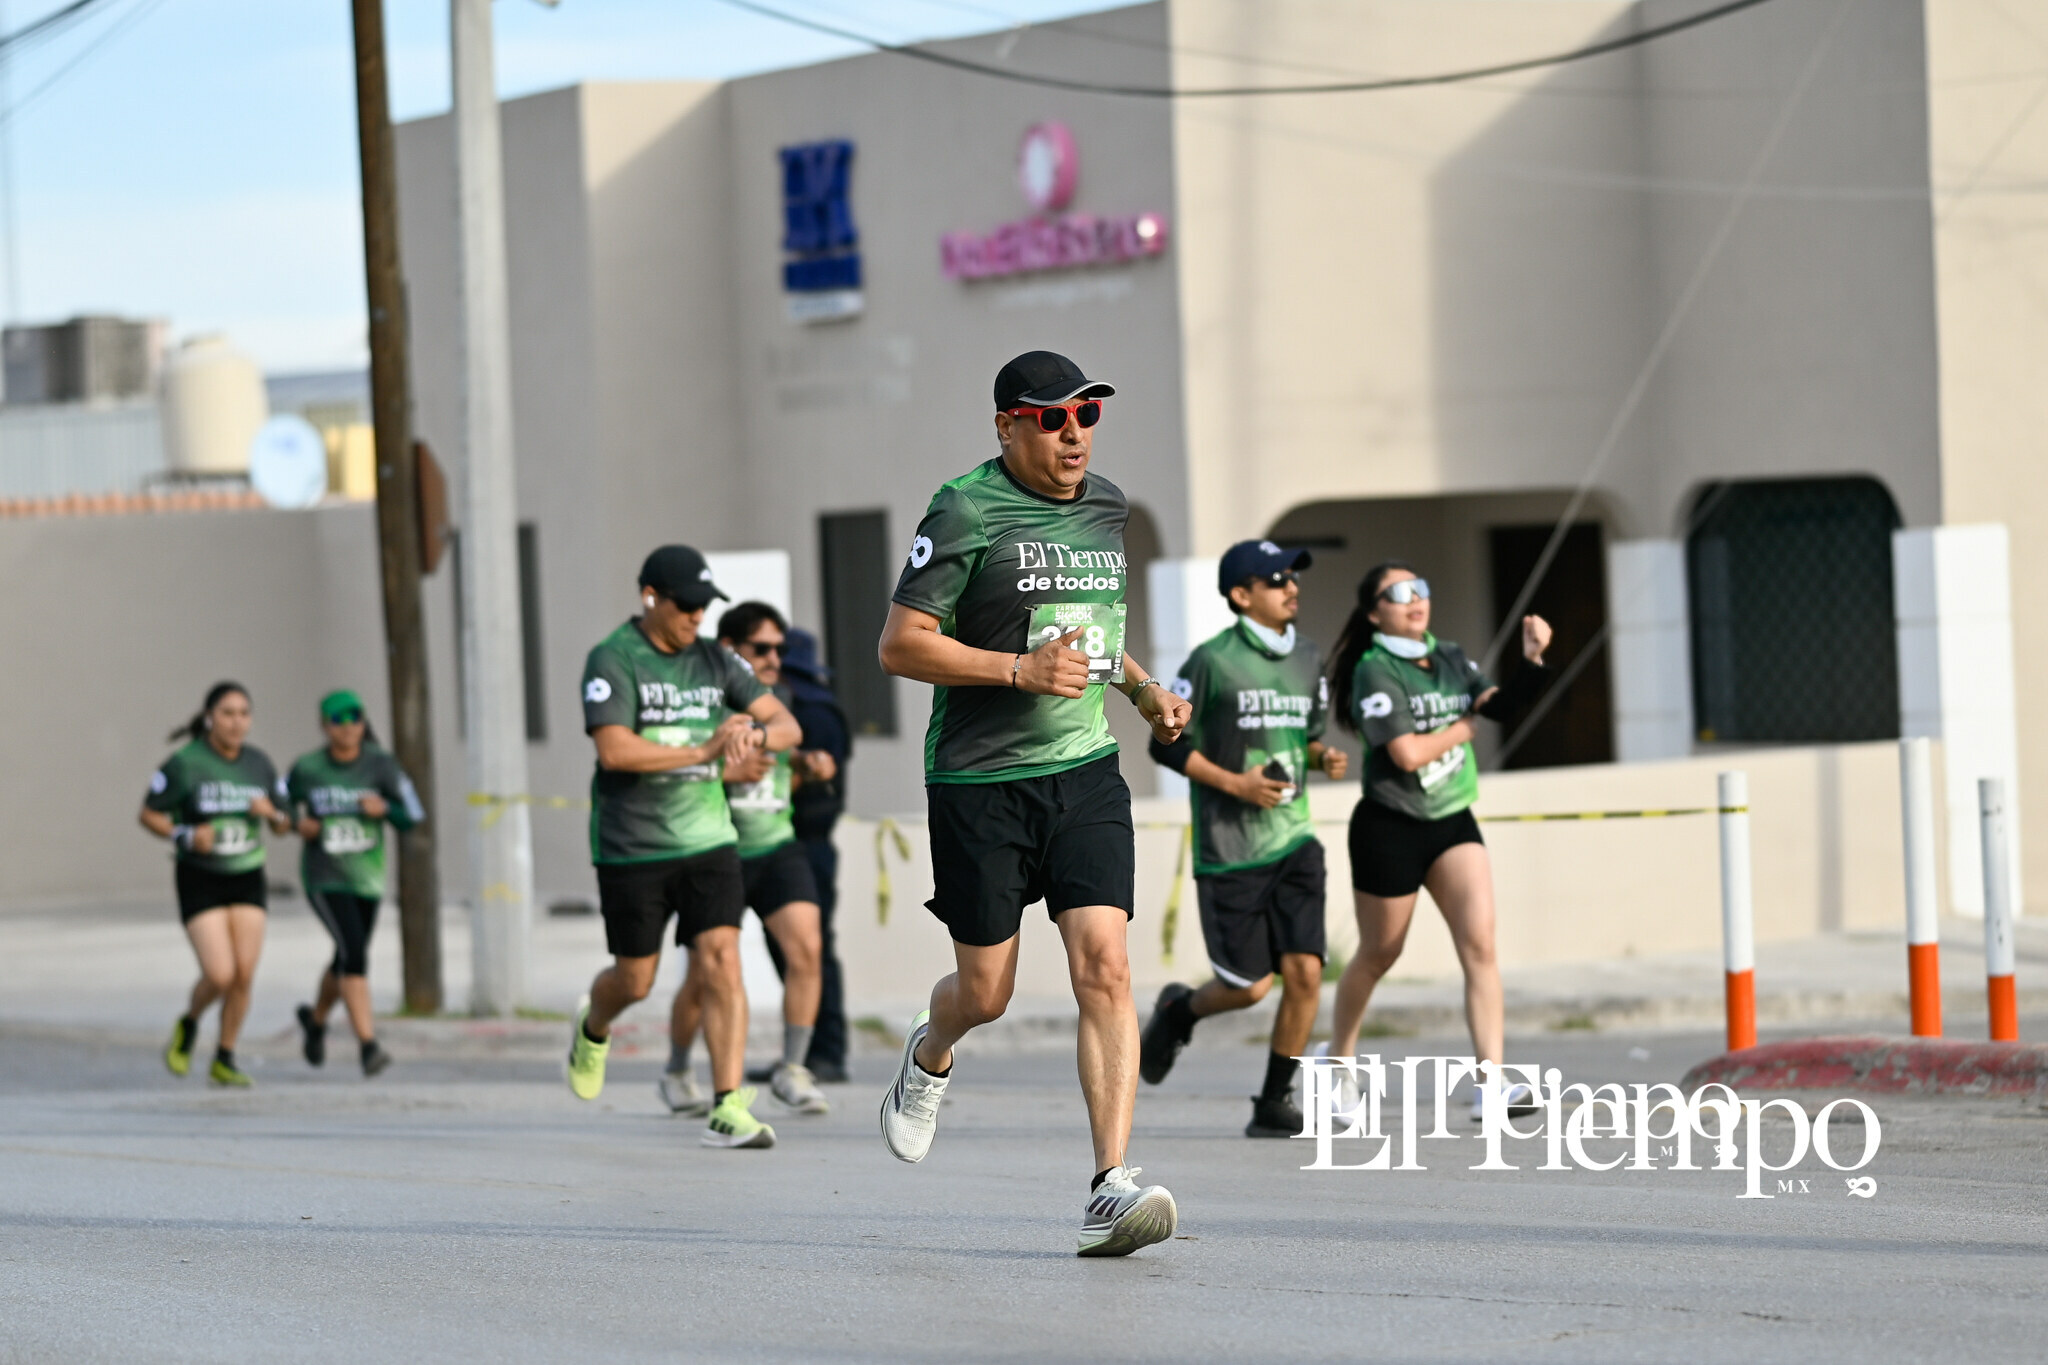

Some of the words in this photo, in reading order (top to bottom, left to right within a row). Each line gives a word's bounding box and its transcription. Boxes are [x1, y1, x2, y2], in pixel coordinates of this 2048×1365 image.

[1014, 541, 1048, 569] El
[1046, 543, 1127, 575] Tiempo
[1016, 573, 1051, 592] de
[1054, 573, 1120, 591] todos
[1113, 621, 1125, 674] MEDALLA
